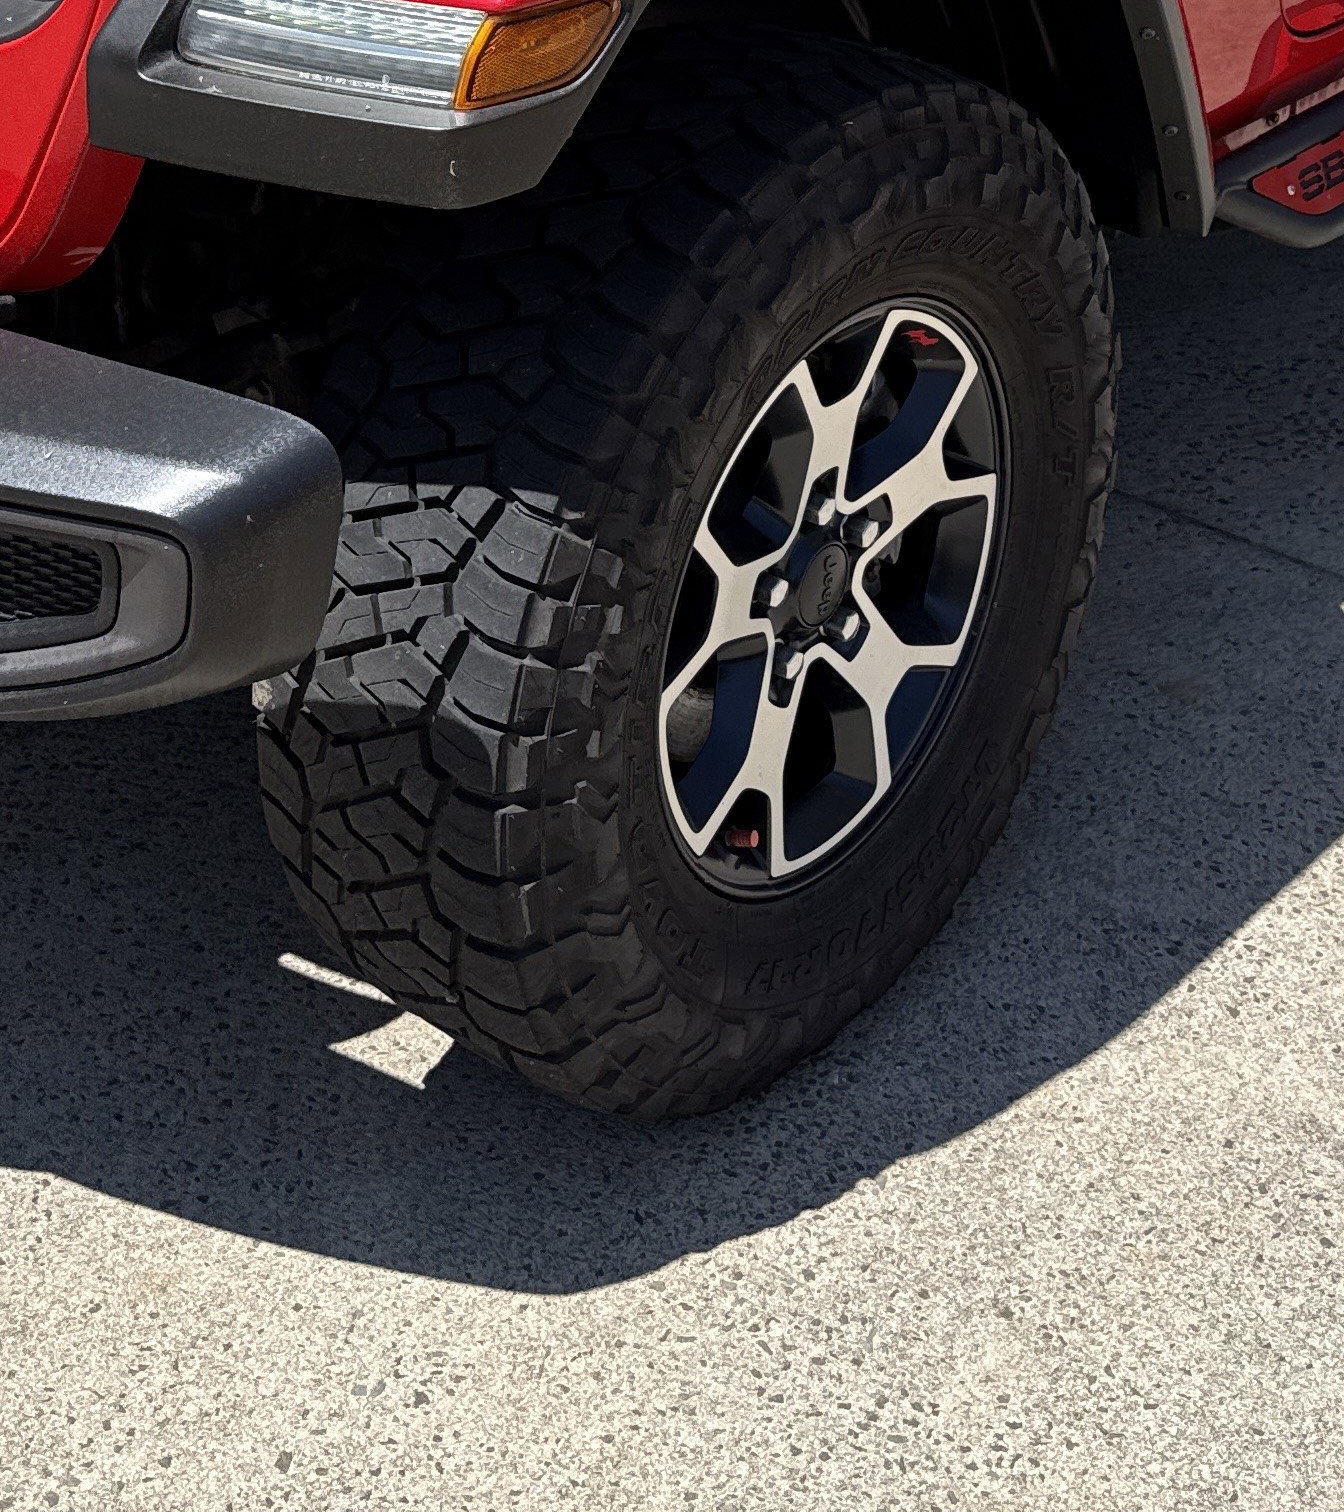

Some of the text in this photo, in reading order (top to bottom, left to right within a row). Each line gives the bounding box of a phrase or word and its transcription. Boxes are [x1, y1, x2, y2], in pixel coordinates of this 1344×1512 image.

[887, 225, 1065, 348] COUNTRY
[1044, 362, 1079, 488] R/T
[817, 553, 838, 618] Jeep
[623, 814, 710, 980] TOYO
